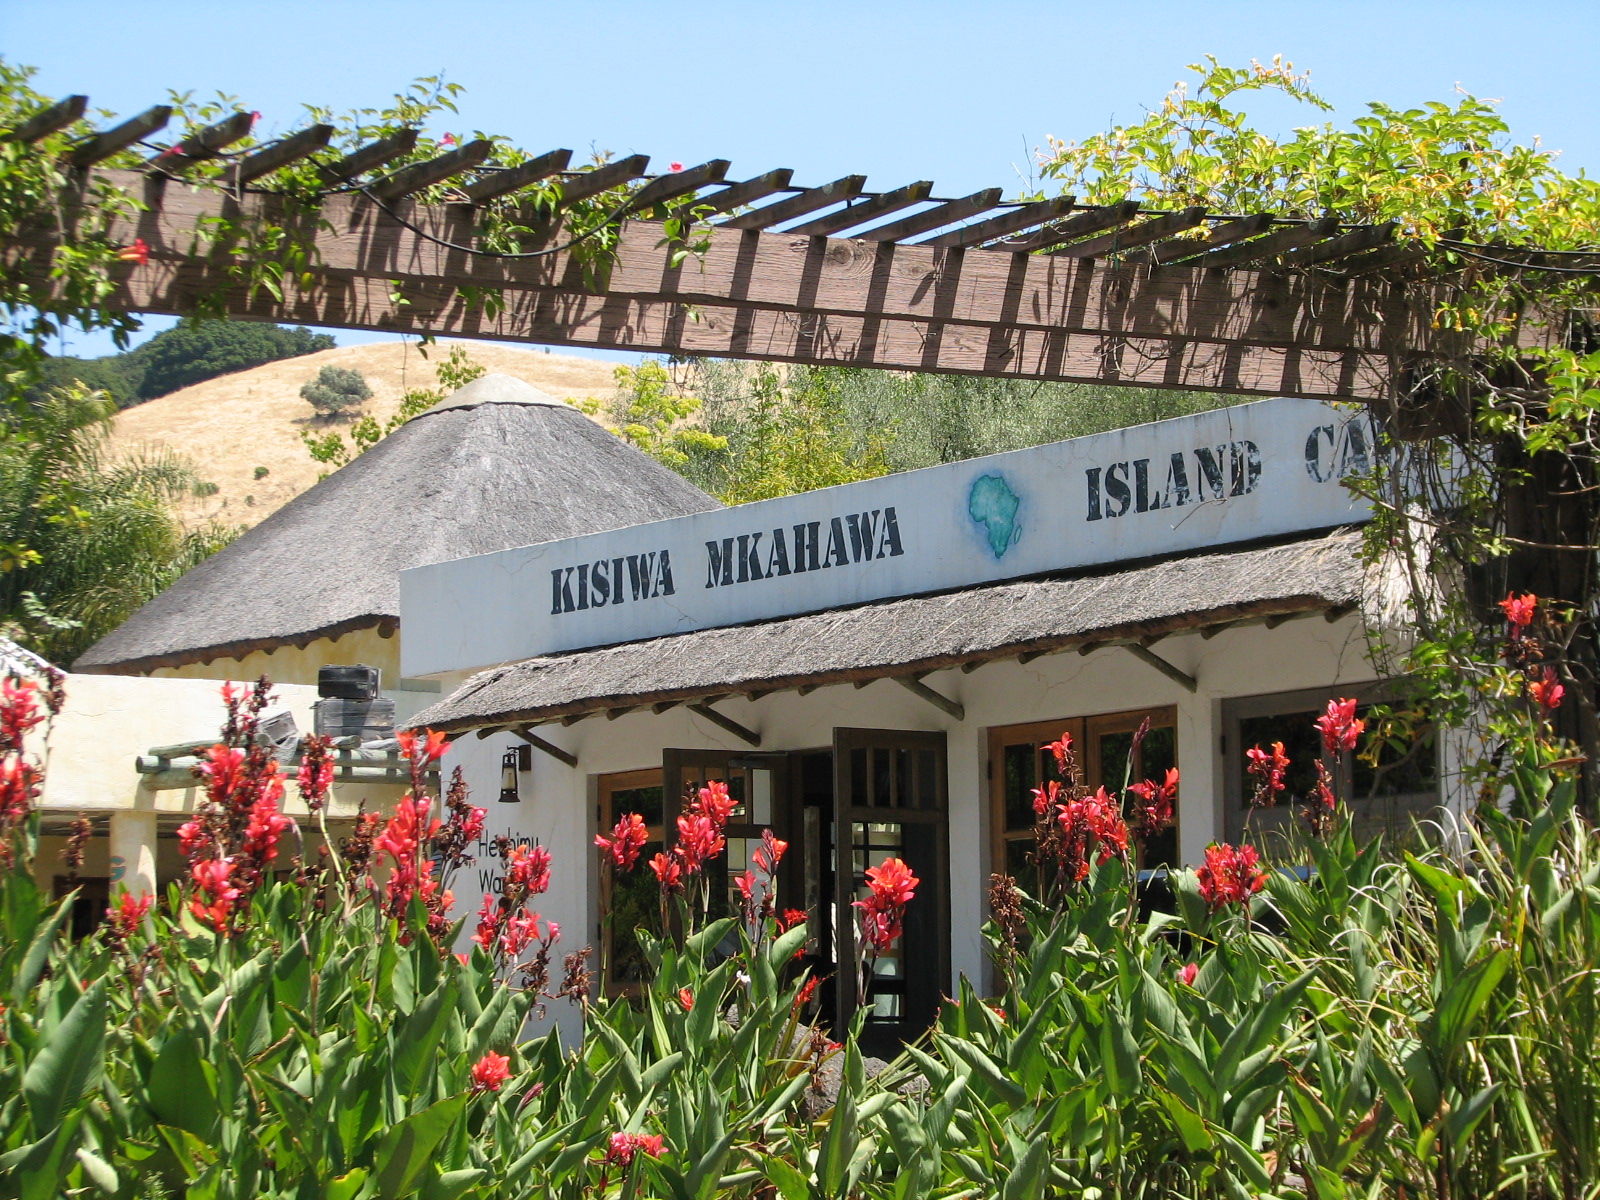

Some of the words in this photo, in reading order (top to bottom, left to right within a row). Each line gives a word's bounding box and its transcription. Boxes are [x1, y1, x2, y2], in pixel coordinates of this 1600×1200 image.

[551, 549, 675, 615] KISIWA
[705, 506, 904, 589] MKAHAWA
[1086, 440, 1262, 522] ISLAND
[478, 826, 539, 857] Hehimu
